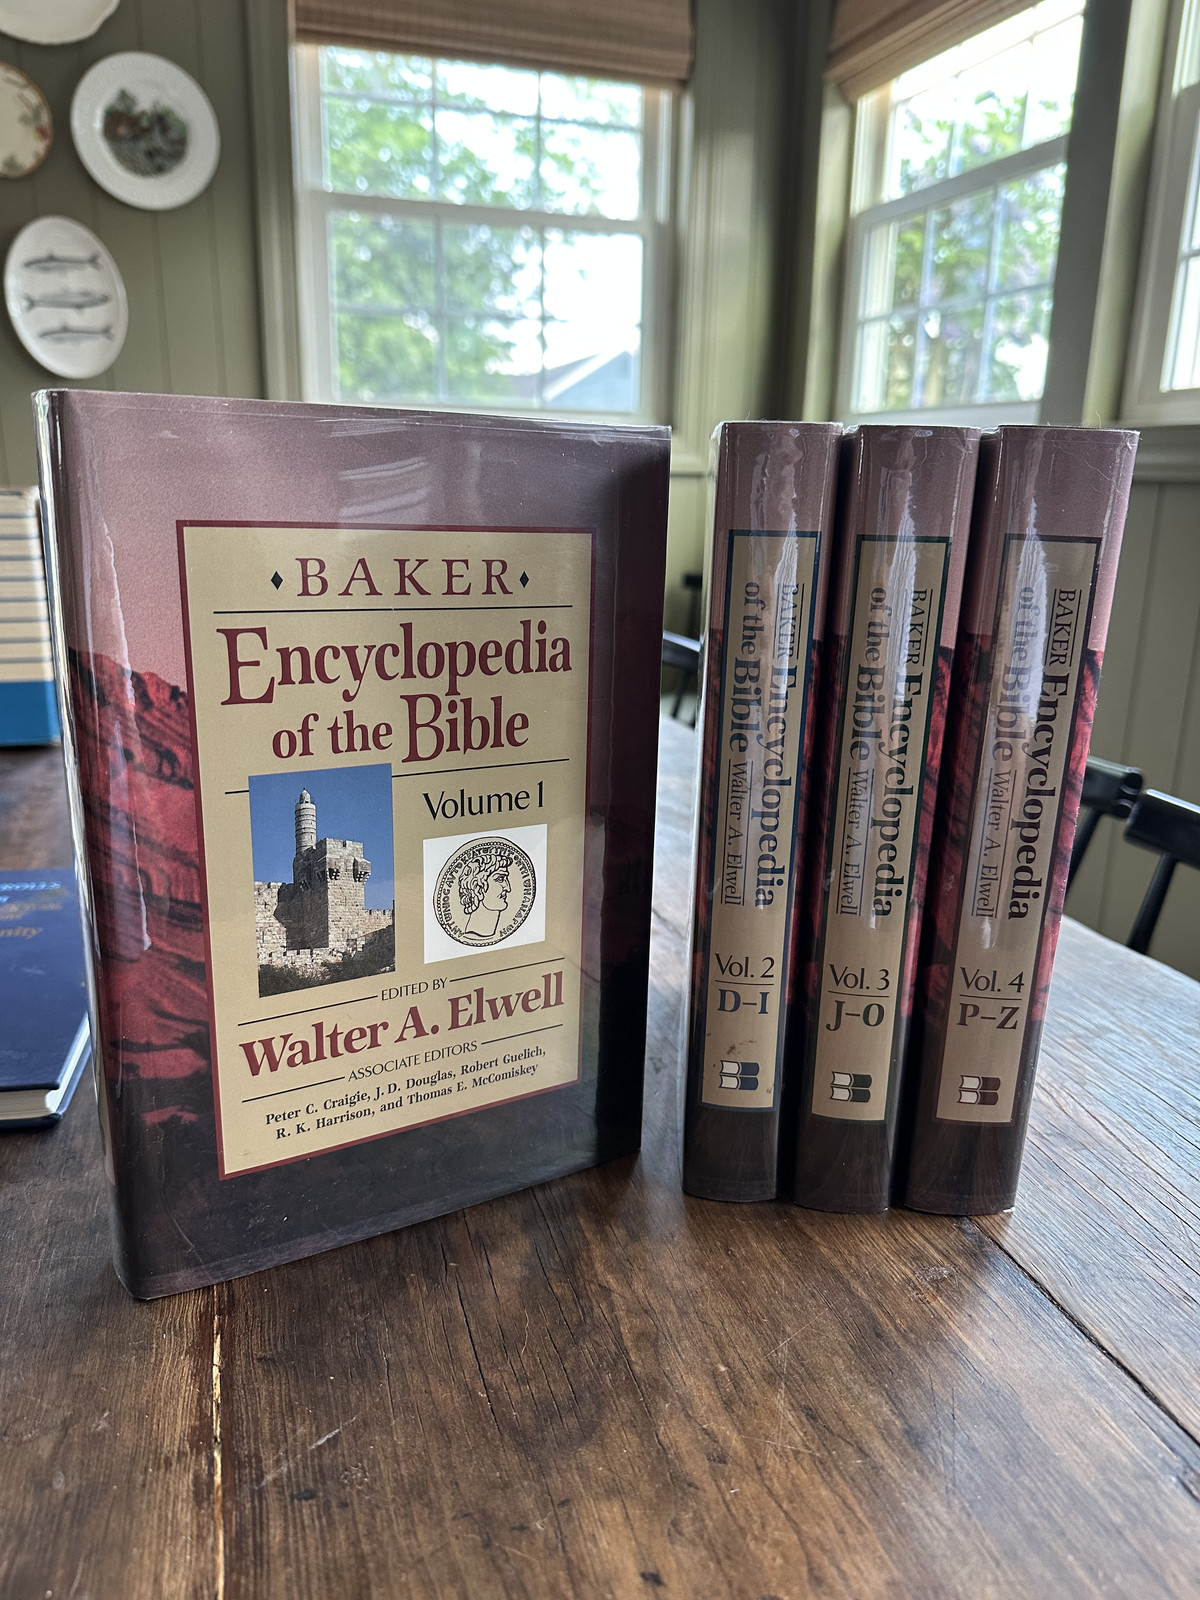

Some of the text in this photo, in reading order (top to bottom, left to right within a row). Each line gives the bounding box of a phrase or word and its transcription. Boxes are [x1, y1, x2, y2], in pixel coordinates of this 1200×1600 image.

[295, 557, 513, 596] BAKER
[216, 619, 572, 706] Encyclopedia
[272, 693, 529, 763] of the Bible
[723, 582, 766, 905] of the Bible Walter A. Elwell
[755, 583, 799, 907] BAKER Encyclopedia
[840, 587, 889, 915] of the Bible Walter A. Elwell
[871, 589, 928, 916] BAKER Encyclopedia
[975, 586, 1039, 918] of the Bible Walter A. Elwell
[1008, 588, 1077, 919] BAKER Encyclopedia
[422, 789, 530, 820] Volume
[381, 978, 448, 1001] EDITED BY
[715, 953, 775, 978] Vol. 2
[829, 964, 890, 990] Vol. 3
[960, 967, 1024, 992] Vol. 4
[239, 971, 563, 1076] Walter A. Elwell
[348, 1041, 478, 1082] ASSOCIATE EDITORS
[265, 1046, 546, 1125] Peter C. Craigie, J. D. Douglas, Robert Guelich,
[276, 1063, 539, 1140] R. K. Harrison, and Thomas E. McComiskey
